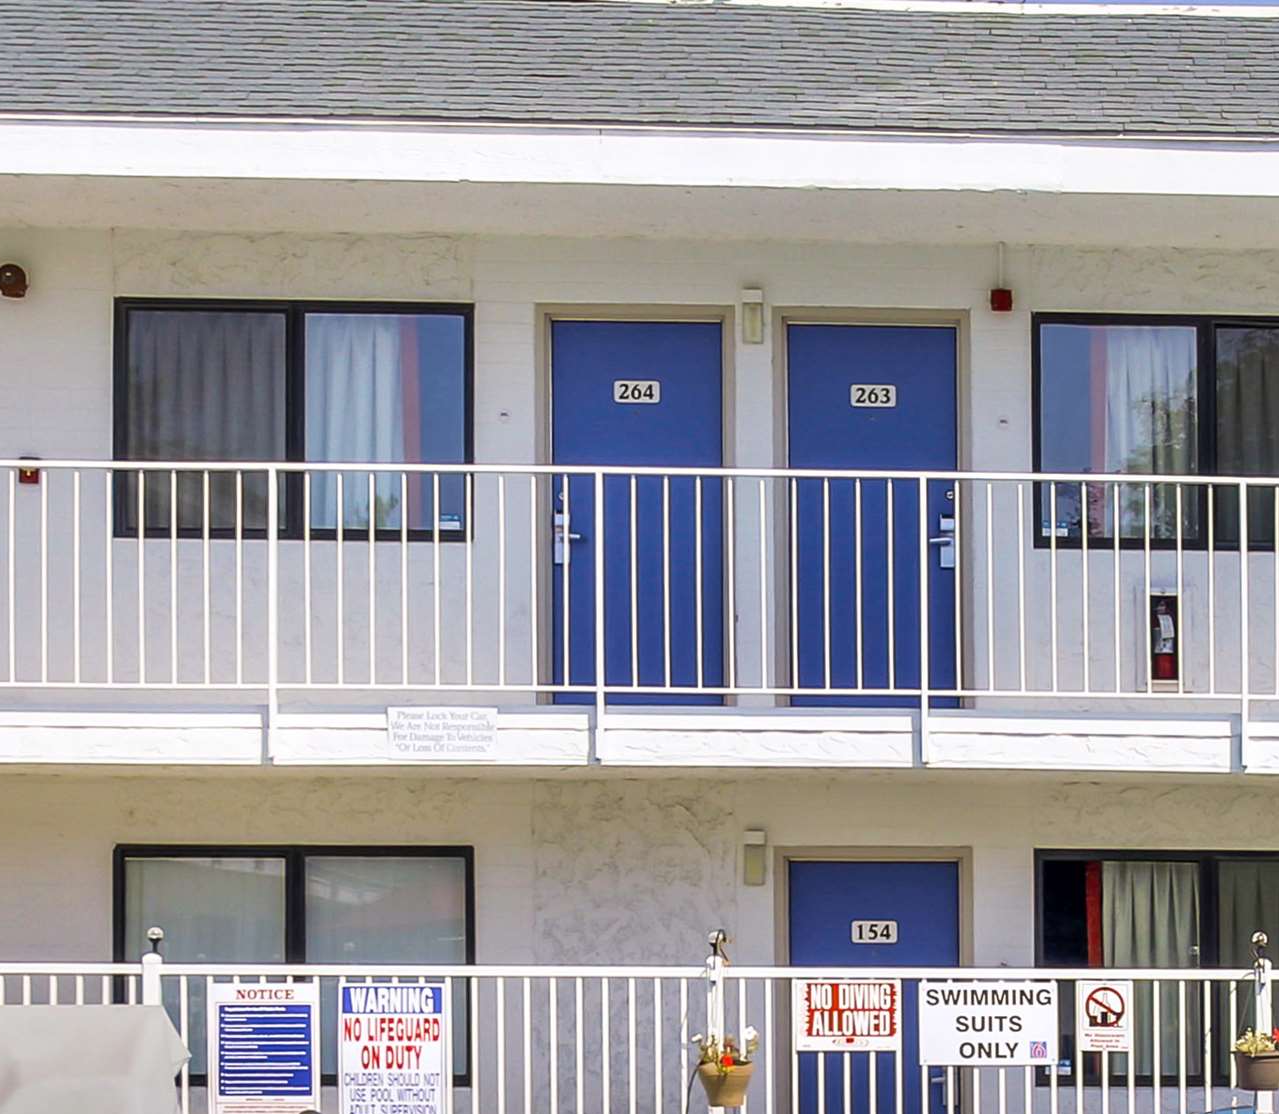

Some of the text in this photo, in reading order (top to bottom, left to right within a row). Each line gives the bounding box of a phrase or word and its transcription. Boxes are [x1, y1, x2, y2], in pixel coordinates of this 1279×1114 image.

[618, 383, 655, 402] 264
[855, 387, 891, 405] 263
[396, 710, 425, 720] Please
[426, 710, 448, 720] Lock
[424, 721, 440, 730] Not
[855, 922, 892, 942] 154
[235, 988, 295, 1000] NOTICE
[349, 987, 434, 1013] WARNING
[810, 983, 892, 1010] NO DIVING
[925, 988, 1052, 1007] SWIMMING
[344, 1017, 440, 1042] NO LIFEGUARD
[811, 1010, 891, 1037] ALLOWED
[955, 1015, 1023, 1033] SUITS
[361, 1045, 422, 1070] ON DUTY
[958, 1042, 1019, 1059] ONLY
[344, 1072, 440, 1087] CHILDREN SHOULD NOT
[349, 1087, 435, 1102] USE POOL WITHOUT
